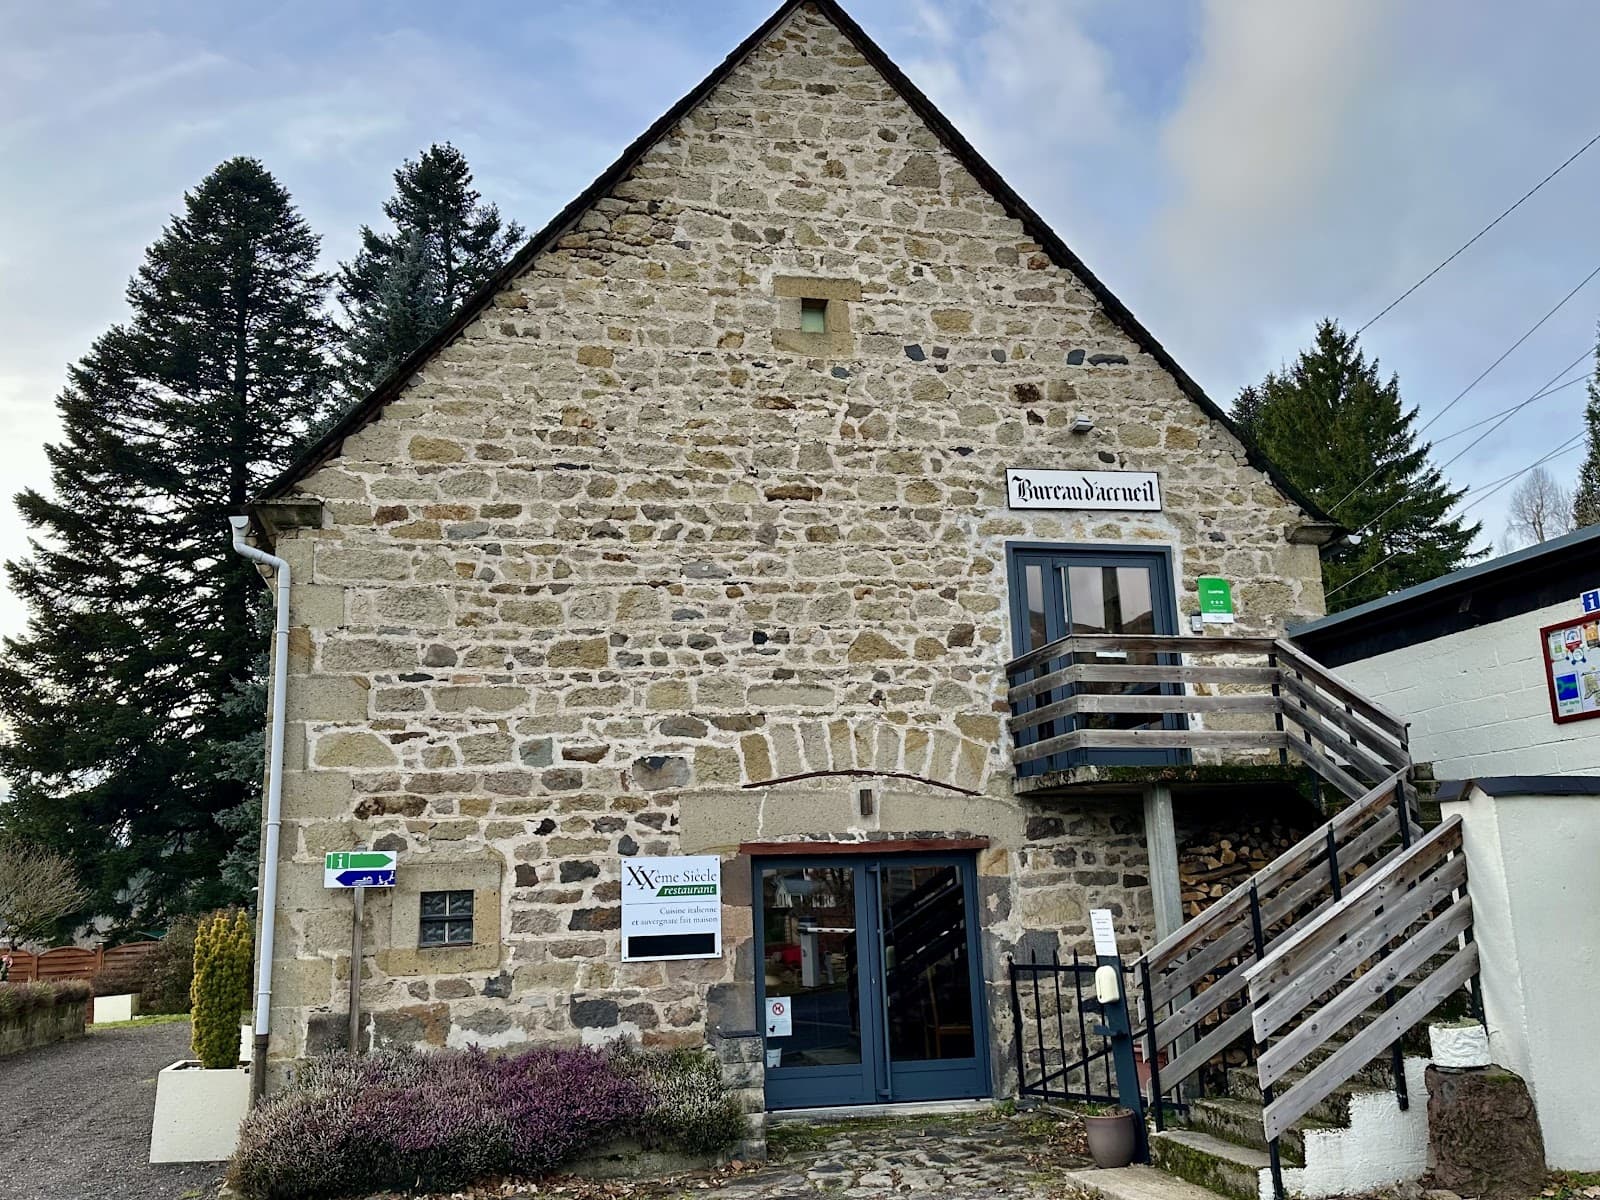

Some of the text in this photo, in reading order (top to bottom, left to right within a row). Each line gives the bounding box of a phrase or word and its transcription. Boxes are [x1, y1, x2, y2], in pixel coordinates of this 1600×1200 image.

[682, 868, 717, 882] Siècle
[663, 887, 714, 895] restaurant
[659, 907, 686, 915] Cuisine
